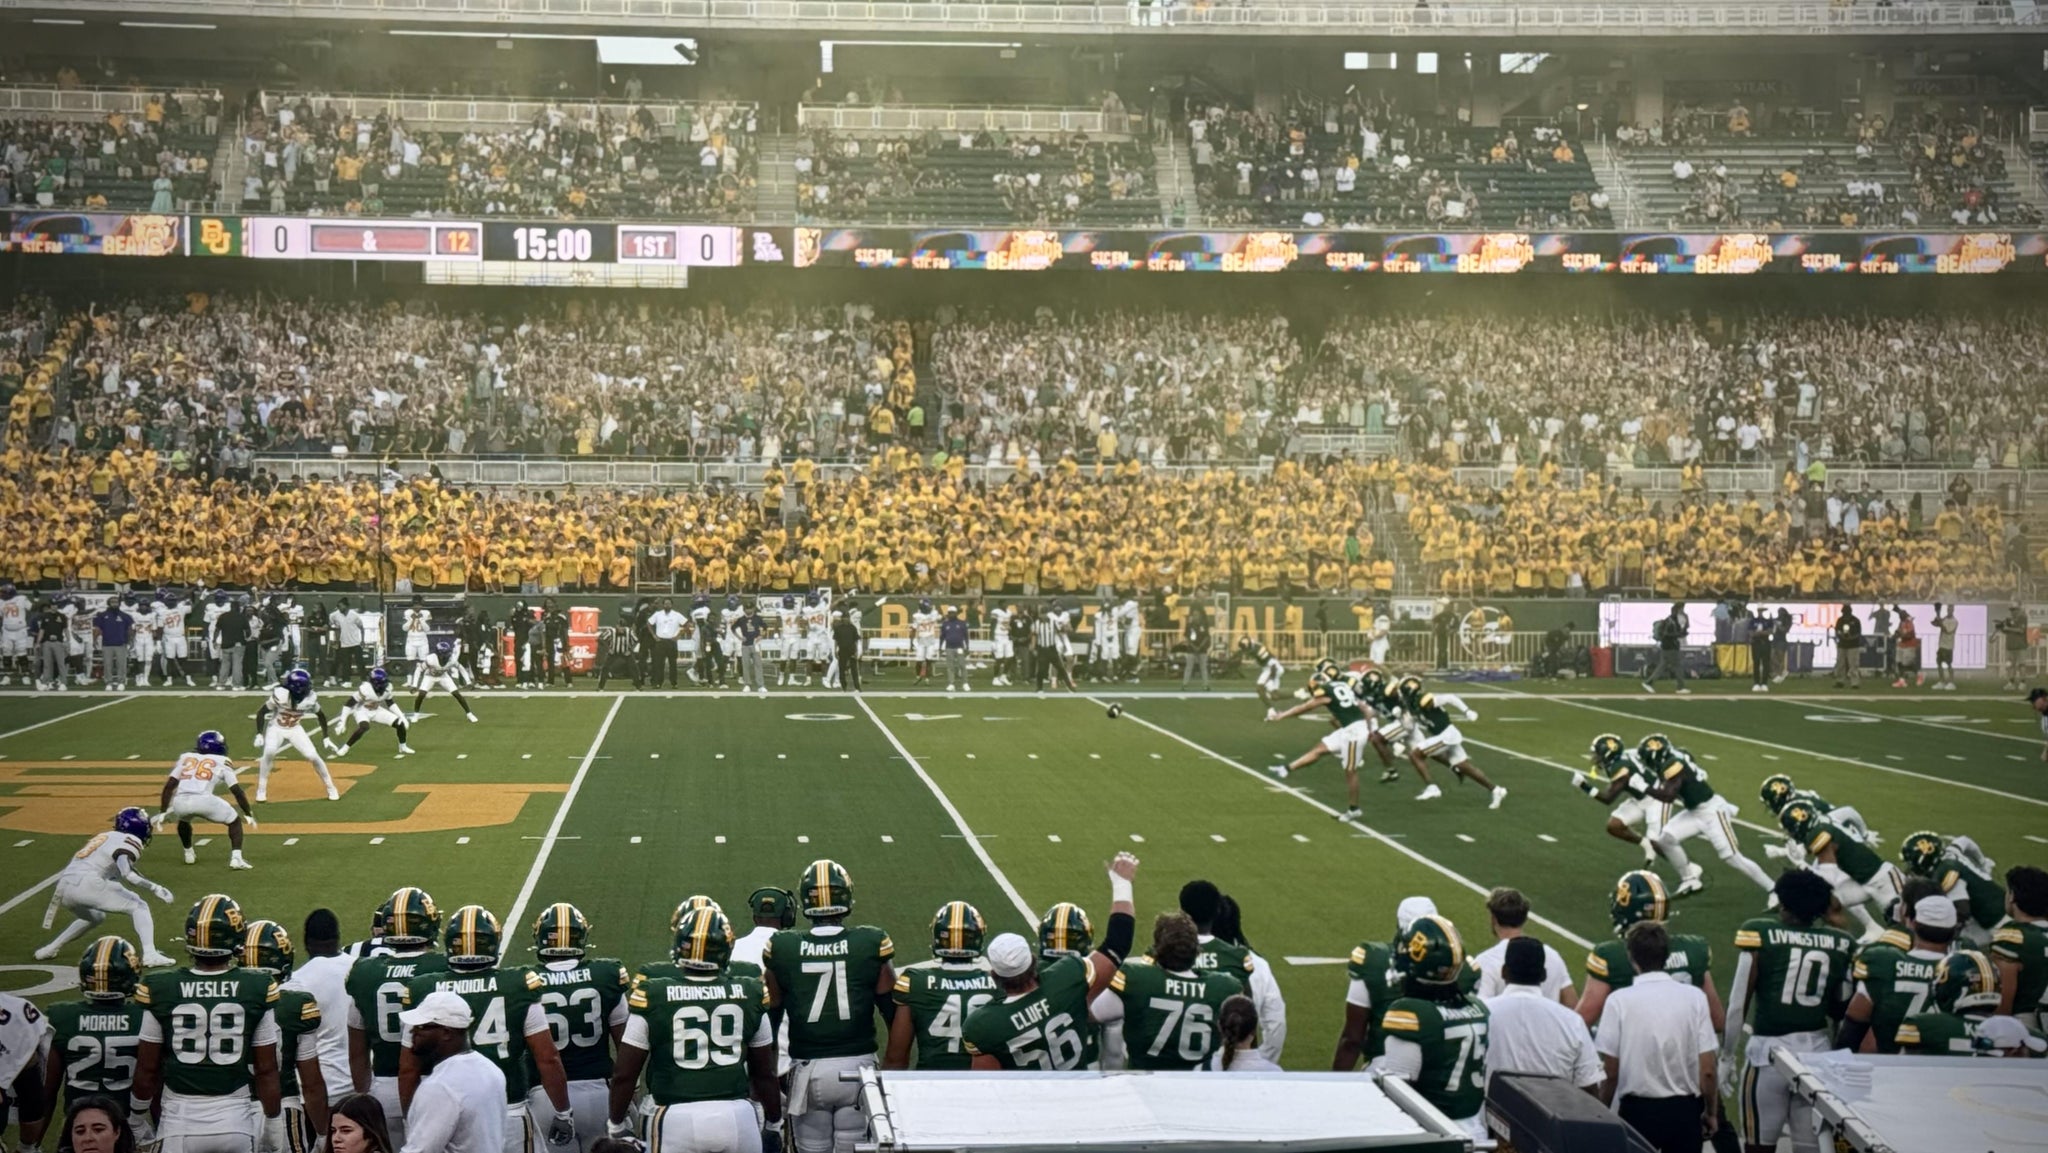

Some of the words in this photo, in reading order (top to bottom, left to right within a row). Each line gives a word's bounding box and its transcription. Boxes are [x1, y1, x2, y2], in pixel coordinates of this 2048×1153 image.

[274, 225, 288, 253] 0
[362, 230, 378, 251] &
[447, 231, 471, 253] 12
[514, 228, 592, 261] 15:00
[633, 236, 668, 257] 1ST
[701, 233, 713, 261] 0
[180, 756, 216, 781] 26
[800, 941, 849, 956] PARKER
[1767, 928, 1835, 950] LIVINGSTON
[180, 981, 240, 999] WESLEY
[435, 976, 498, 995] MENDIOLA
[539, 969, 592, 987] SWANER
[927, 976, 938, 990] P.
[941, 976, 997, 991] ALMANZA
[1165, 978, 1206, 999] PETTY
[1781, 947, 1831, 1008] 10
[667, 985, 726, 1001] ROBINSON
[729, 984, 748, 999] JR.
[801, 960, 850, 1023] 71
[78, 1014, 130, 1032] MORRIS
[540, 987, 603, 1051] 63
[1010, 999, 1051, 1032] CLUFF
[171, 1002, 245, 1066] 88
[672, 1003, 745, 1070] 69
[1006, 1012, 1083, 1071] 56
[1146, 997, 1214, 1062] 76
[66, 1035, 140, 1092] 25
